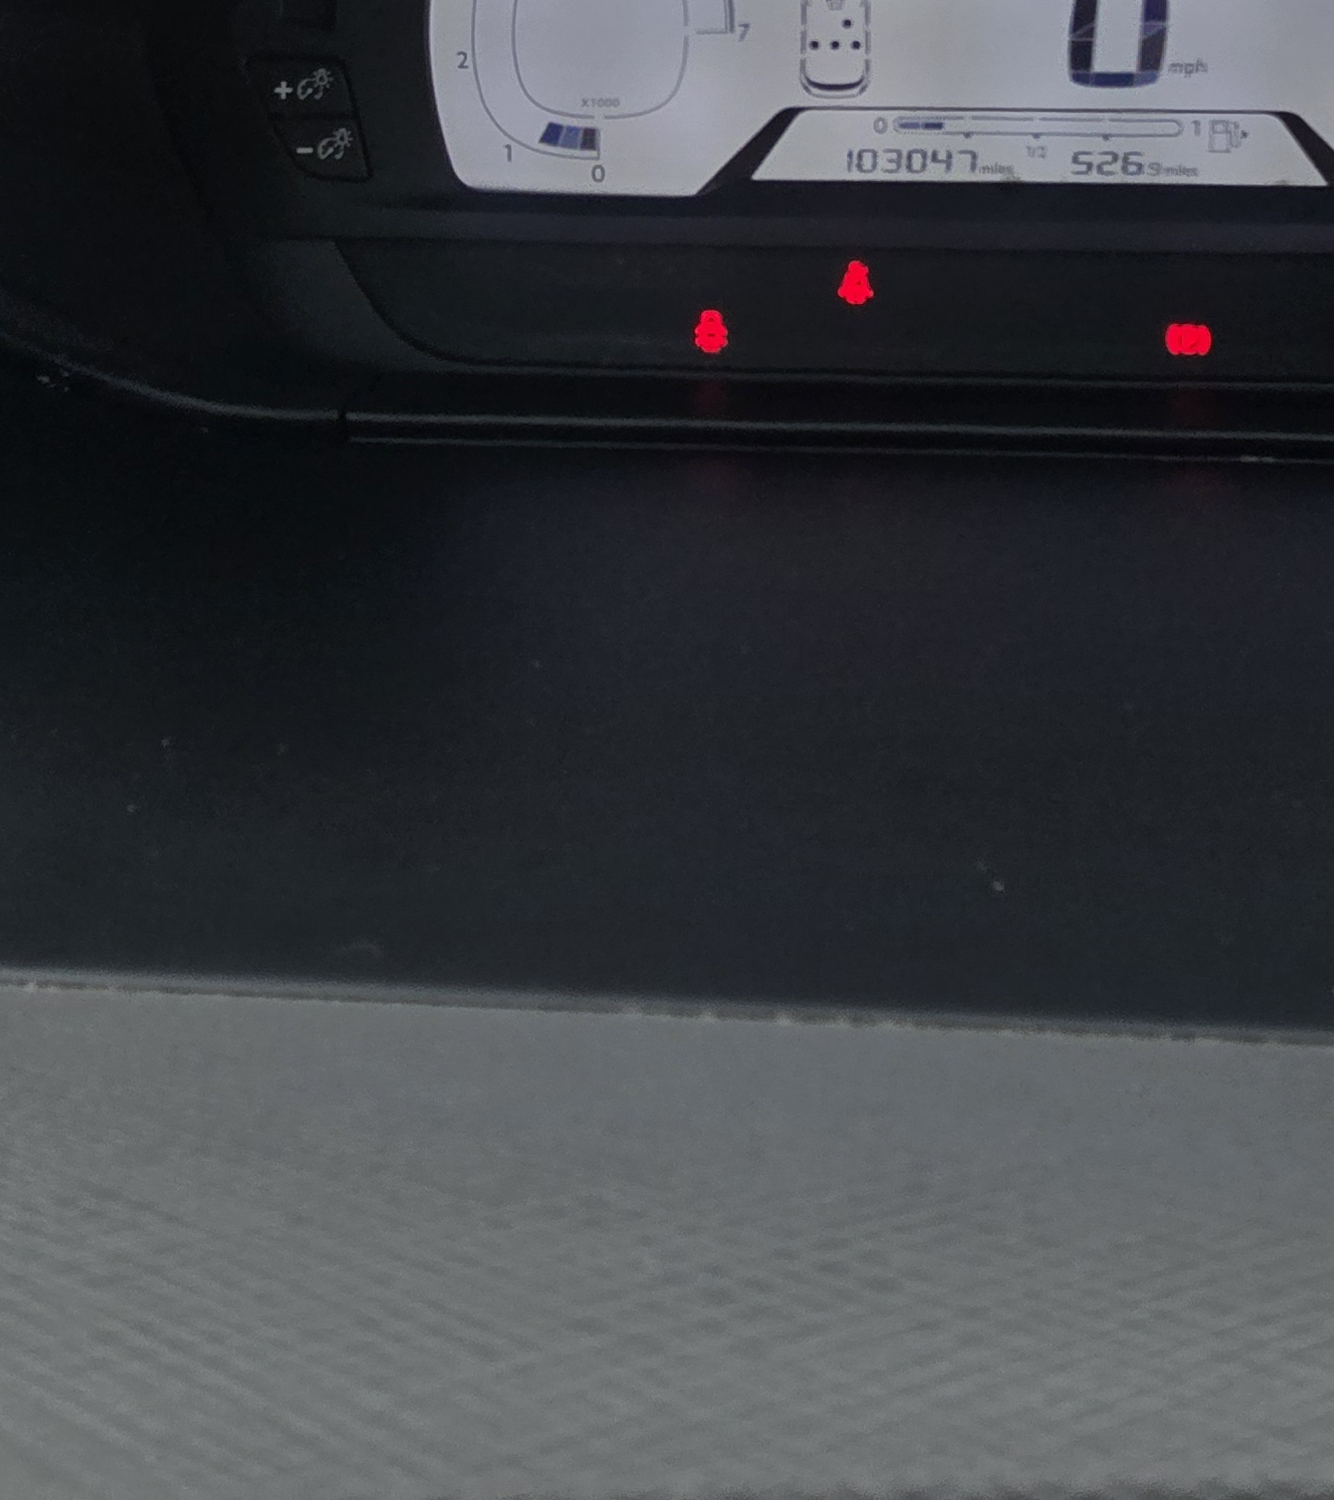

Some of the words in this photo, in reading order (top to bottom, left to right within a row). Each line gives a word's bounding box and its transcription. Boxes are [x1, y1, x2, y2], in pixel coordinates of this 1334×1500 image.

[739, 23, 751, 42] 7
[457, 51, 469, 70] 2
[1168, 59, 1208, 77] mph
[873, 117, 888, 134] 0
[1191, 120, 1201, 136] 1
[504, 144, 513, 162] 1
[591, 164, 606, 183] 0
